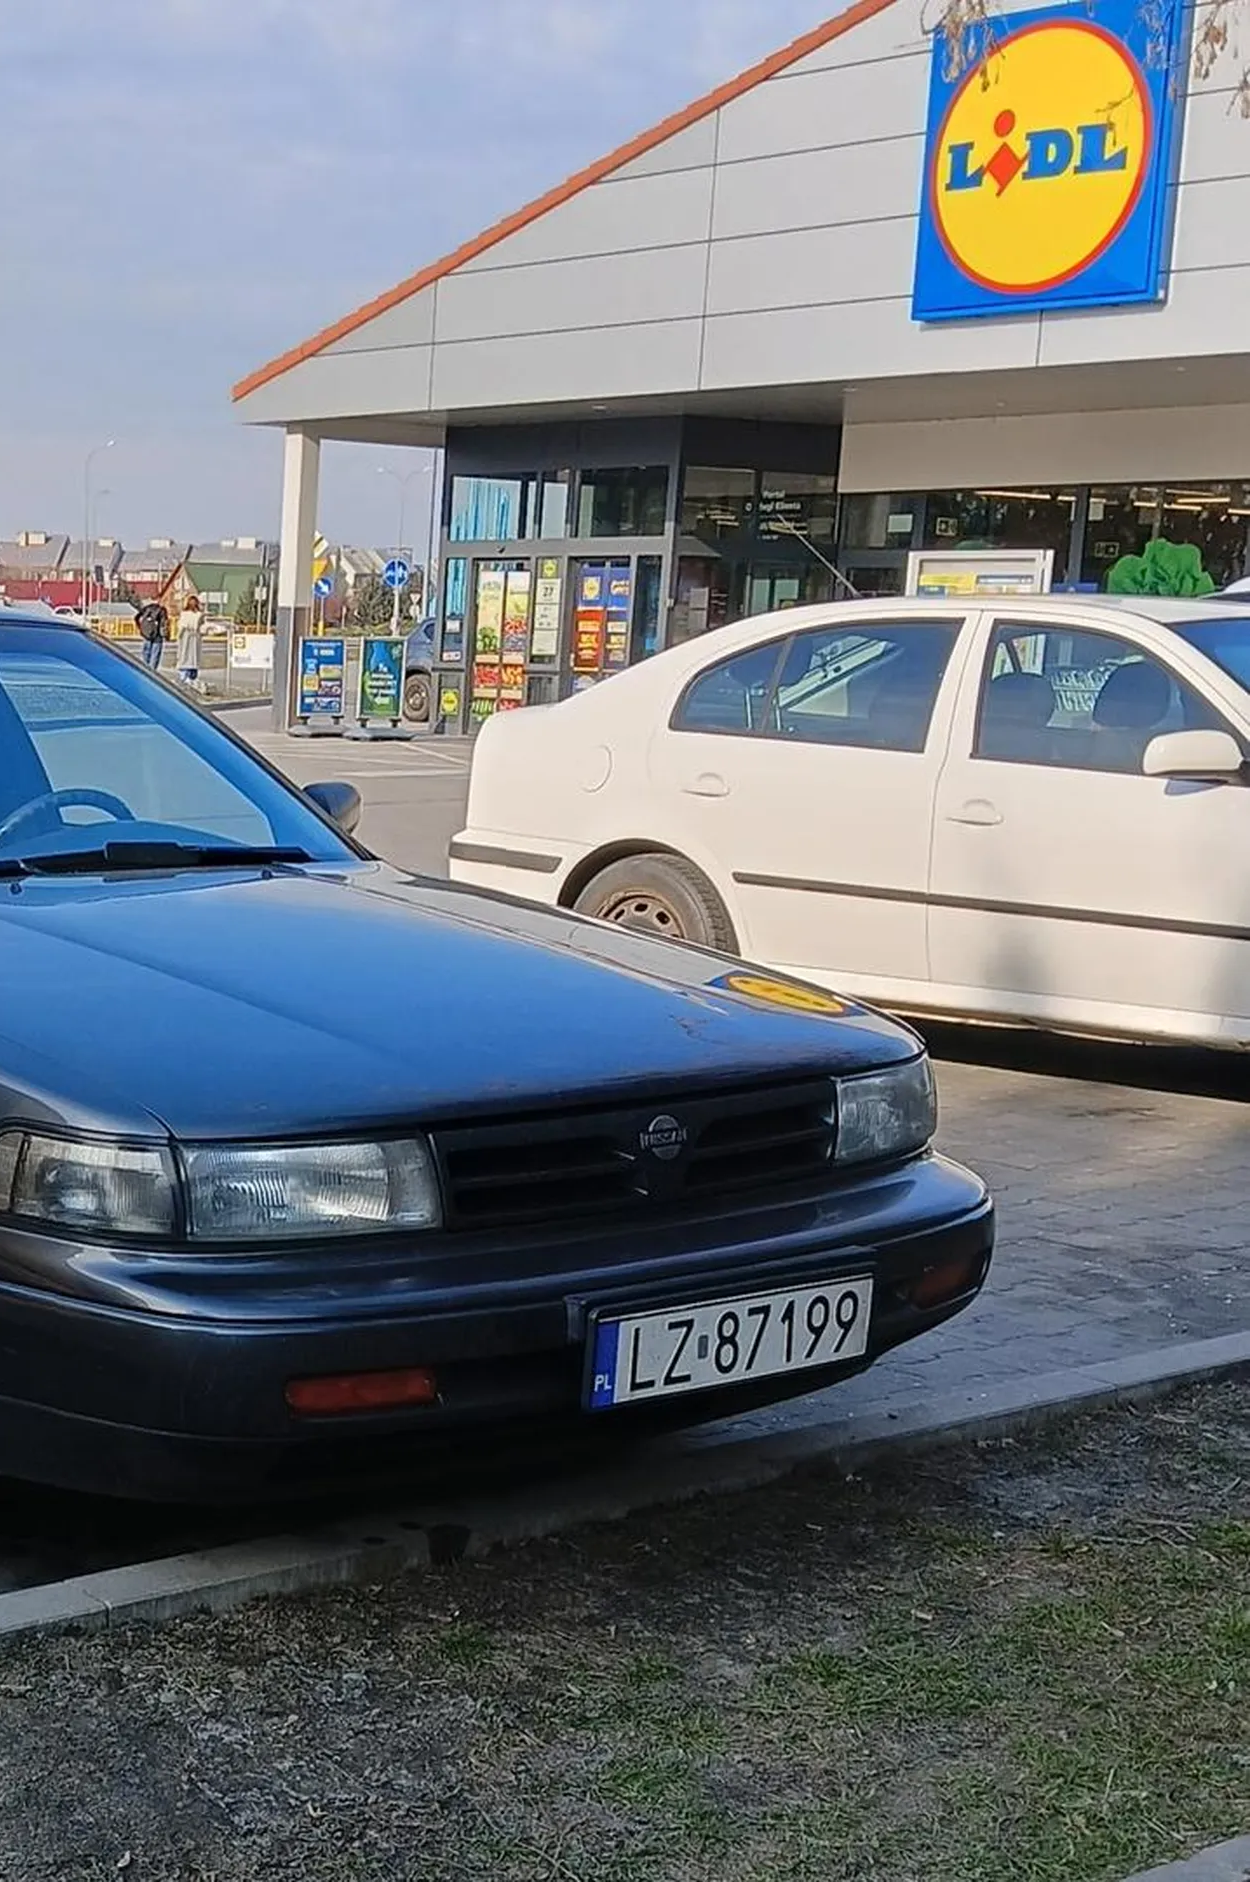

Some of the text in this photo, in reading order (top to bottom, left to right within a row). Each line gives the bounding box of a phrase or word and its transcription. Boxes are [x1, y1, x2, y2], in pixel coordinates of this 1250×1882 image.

[629, 1290, 859, 1392] LZ 87199
[594, 1374, 612, 1393] PL
